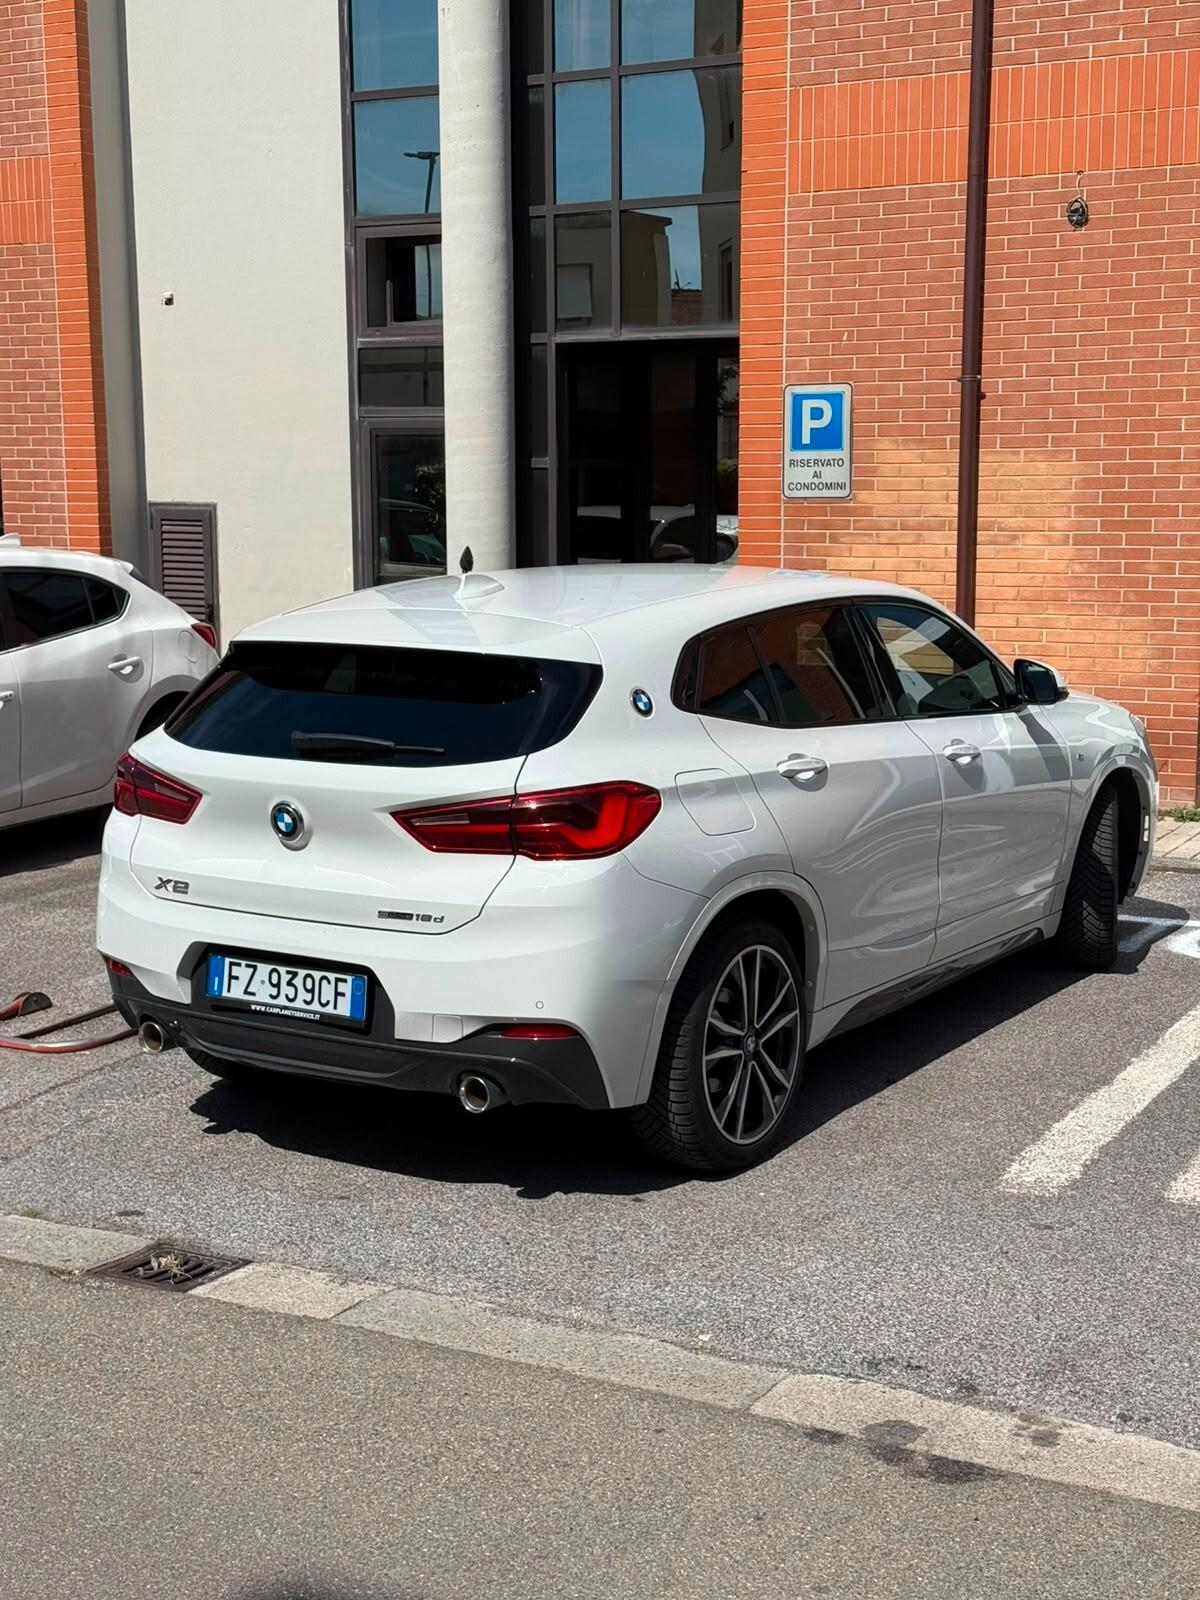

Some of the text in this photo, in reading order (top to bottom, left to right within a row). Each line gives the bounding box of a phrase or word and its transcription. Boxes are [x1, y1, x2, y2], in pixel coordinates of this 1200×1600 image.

[802, 399, 832, 444] P
[788, 458, 845, 468] RISERVATO
[812, 470, 822, 479] AI
[787, 481, 847, 491] CONDOMINI
[154, 876, 189, 895] X2
